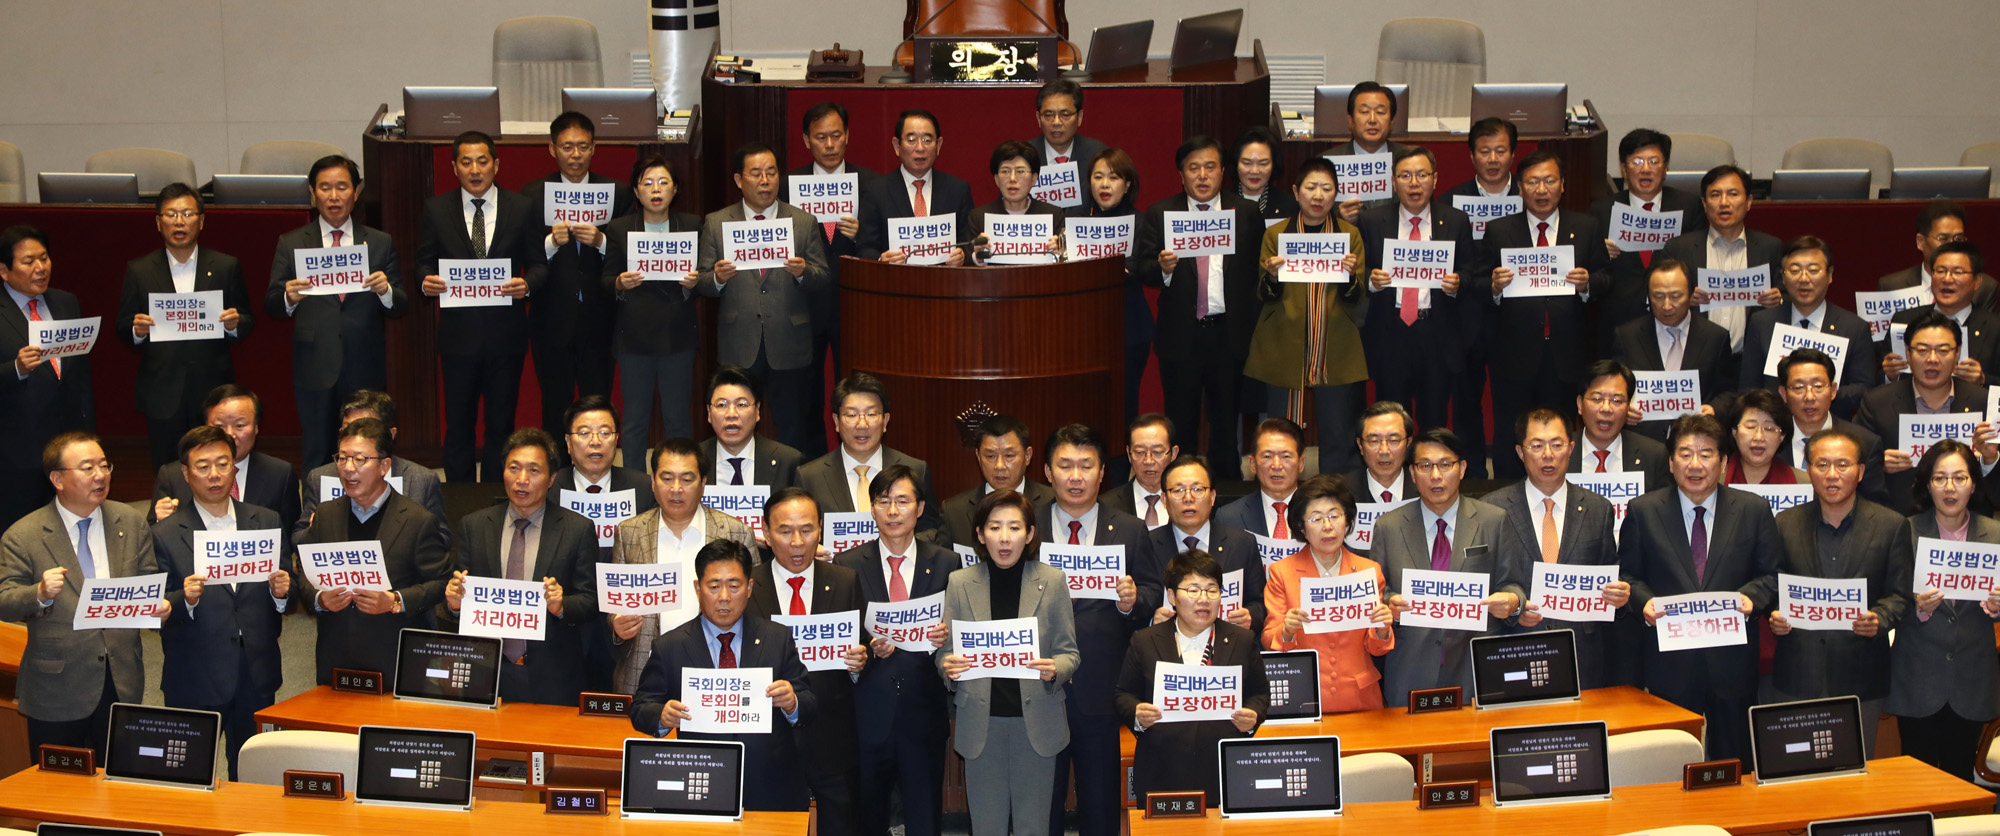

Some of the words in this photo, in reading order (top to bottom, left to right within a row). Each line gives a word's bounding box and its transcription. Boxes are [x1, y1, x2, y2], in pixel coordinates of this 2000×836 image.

[949, 46, 1024, 76] 의장
[1333, 161, 1387, 177] 민생법안
[1033, 170, 1075, 188] 리버스터
[1336, 179, 1387, 195] 처리하라
[554, 189, 610, 205] 민생법안
[798, 182, 853, 197] 민생법안
[1034, 186, 1077, 202] 장하라
[554, 207, 608, 224] 처리하라
[800, 200, 853, 215] 처리하라
[1462, 203, 1517, 217] 민생법안
[992, 222, 1048, 237] 민생법안
[1171, 218, 1231, 233] 필리버스터
[1621, 213, 1676, 229] 민생법안
[732, 228, 788, 244] 민생법안
[898, 222, 951, 240] 민생법안
[1075, 223, 1129, 239] 민생법안
[1618, 230, 1674, 243] 처리하라
[636, 239, 692, 255] 민생법안
[899, 241, 951, 257] 처리하라
[993, 241, 1048, 255] 처리하라
[1076, 242, 1128, 258] 처리하라
[1172, 235, 1231, 250] 보장하라
[1285, 241, 1345, 256] 필리버스터
[305, 252, 363, 269] 민생법안
[733, 246, 790, 264] 처리하라
[1393, 247, 1449, 262] 민생법안
[1506, 252, 1557, 265] 국회의장은
[449, 266, 505, 280] 민생법안
[637, 258, 693, 274] 처리하라
[1286, 257, 1343, 274] 보장하라
[1391, 265, 1446, 281] 처리하라
[1518, 265, 1558, 276] 본회의를
[306, 270, 364, 287] 처리하라
[1529, 276, 1566, 289] 개의하라
[1708, 274, 1765, 289] 민생법안
[449, 284, 506, 299] 처리하라
[1709, 290, 1764, 305] 처리하라
[154, 298, 206, 310] 국회의장은
[1864, 296, 1921, 315] 민생법안
[165, 310, 206, 321] 본회의를
[39, 325, 94, 344] 민생법안
[177, 321, 214, 333] 개의하라
[39, 341, 90, 358] 처리하라
[1636, 378, 1694, 393] 민생법안
[1637, 397, 1695, 412] 처리하라
[1910, 422, 1975, 439] 민생법안
[1572, 481, 1640, 498] 리버스터
[205, 538, 276, 557] 민생법안
[312, 550, 377, 567] 민생법안
[1048, 554, 1120, 571] 필리버스터
[1929, 549, 1998, 568] 민생법안
[206, 560, 274, 578] 처리하라
[318, 569, 383, 587] 처리하라
[606, 572, 676, 587] 필리버스터
[1068, 573, 1117, 590] 장하라
[1545, 572, 1611, 589] 민생법안
[1926, 572, 1996, 591] 처리하라
[90, 583, 160, 600] 필리버스터
[473, 586, 541, 606] 민생법안
[1310, 580, 1376, 600] 필리버스터
[1411, 579, 1482, 599] 필리버스터
[1788, 583, 1861, 601] 필리버스터
[607, 590, 677, 608] 보장하라
[1542, 593, 1608, 613] 처리하라
[1664, 599, 1737, 616] 필리버스터
[84, 603, 158, 619] 보장하라
[875, 603, 942, 624] 필리버스터
[1311, 601, 1376, 622] 보장하라
[1411, 601, 1482, 620] 보장하라
[1789, 605, 1861, 622] 보장하라
[472, 611, 540, 628] 처리하라
[1667, 617, 1739, 639] 보장하라
[790, 621, 853, 641] 민생법안
[960, 628, 1034, 648] 필리버스터
[798, 644, 853, 663] 리하라
[963, 652, 1033, 669] 보장하라
[687, 676, 751, 691] 국회의장은
[1163, 673, 1236, 691] 필리버스터
[700, 692, 751, 708] 본회의를
[1163, 694, 1237, 712] 보장하라
[714, 708, 760, 724] 개의하라
